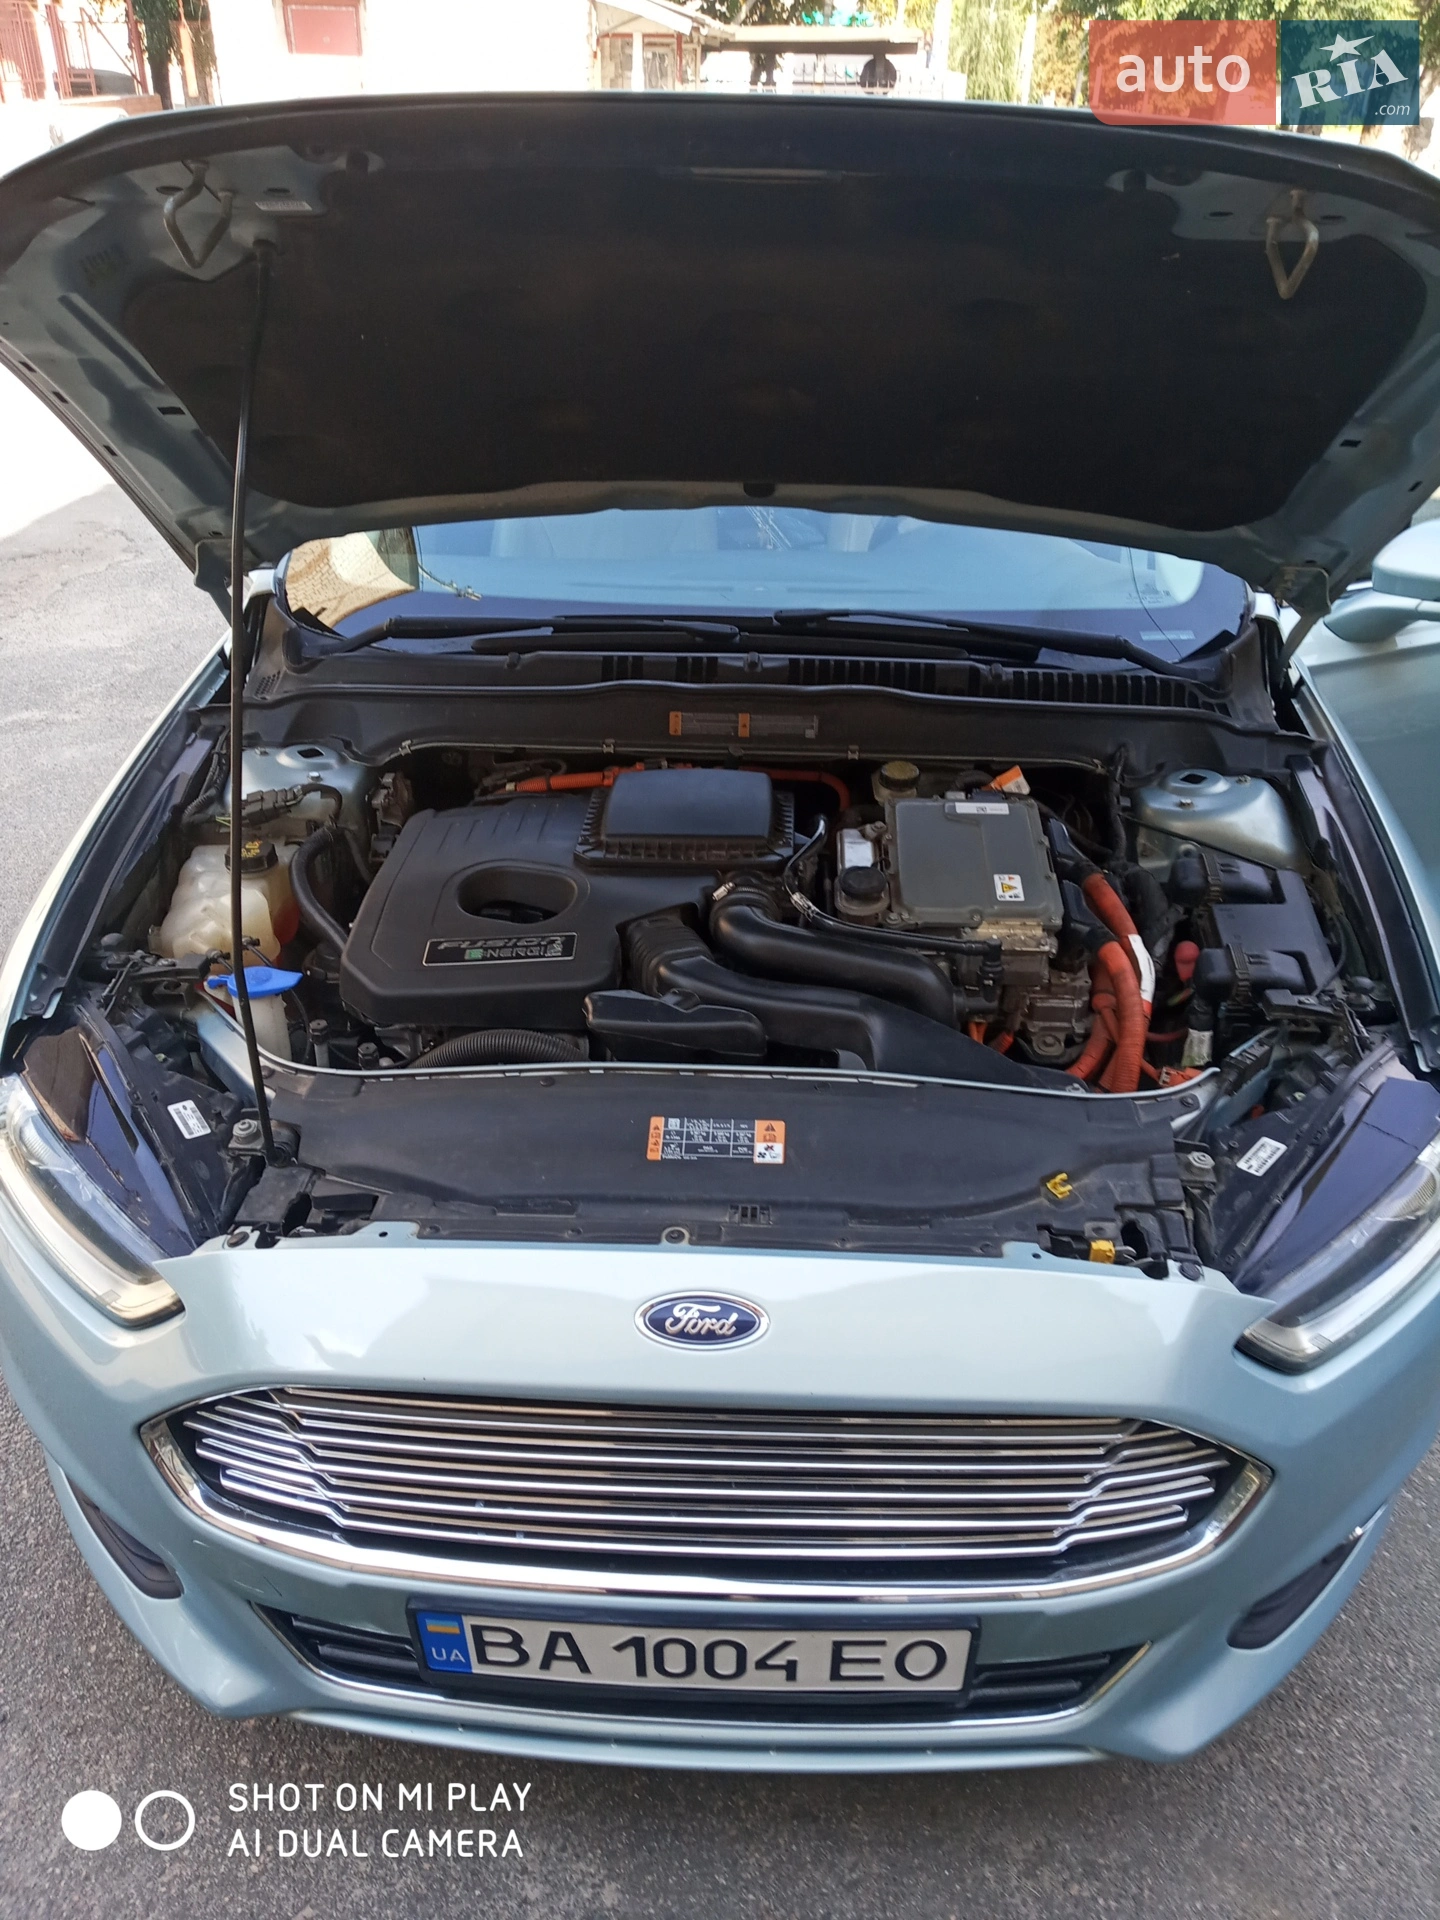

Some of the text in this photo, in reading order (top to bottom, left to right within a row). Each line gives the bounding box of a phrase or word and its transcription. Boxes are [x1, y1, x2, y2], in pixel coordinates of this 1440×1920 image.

[438, 937, 565, 950] FUSION
[665, 1302, 739, 1336] Ford
[431, 1647, 466, 1663] UA
[470, 1624, 948, 1683] BA 1004 EO
